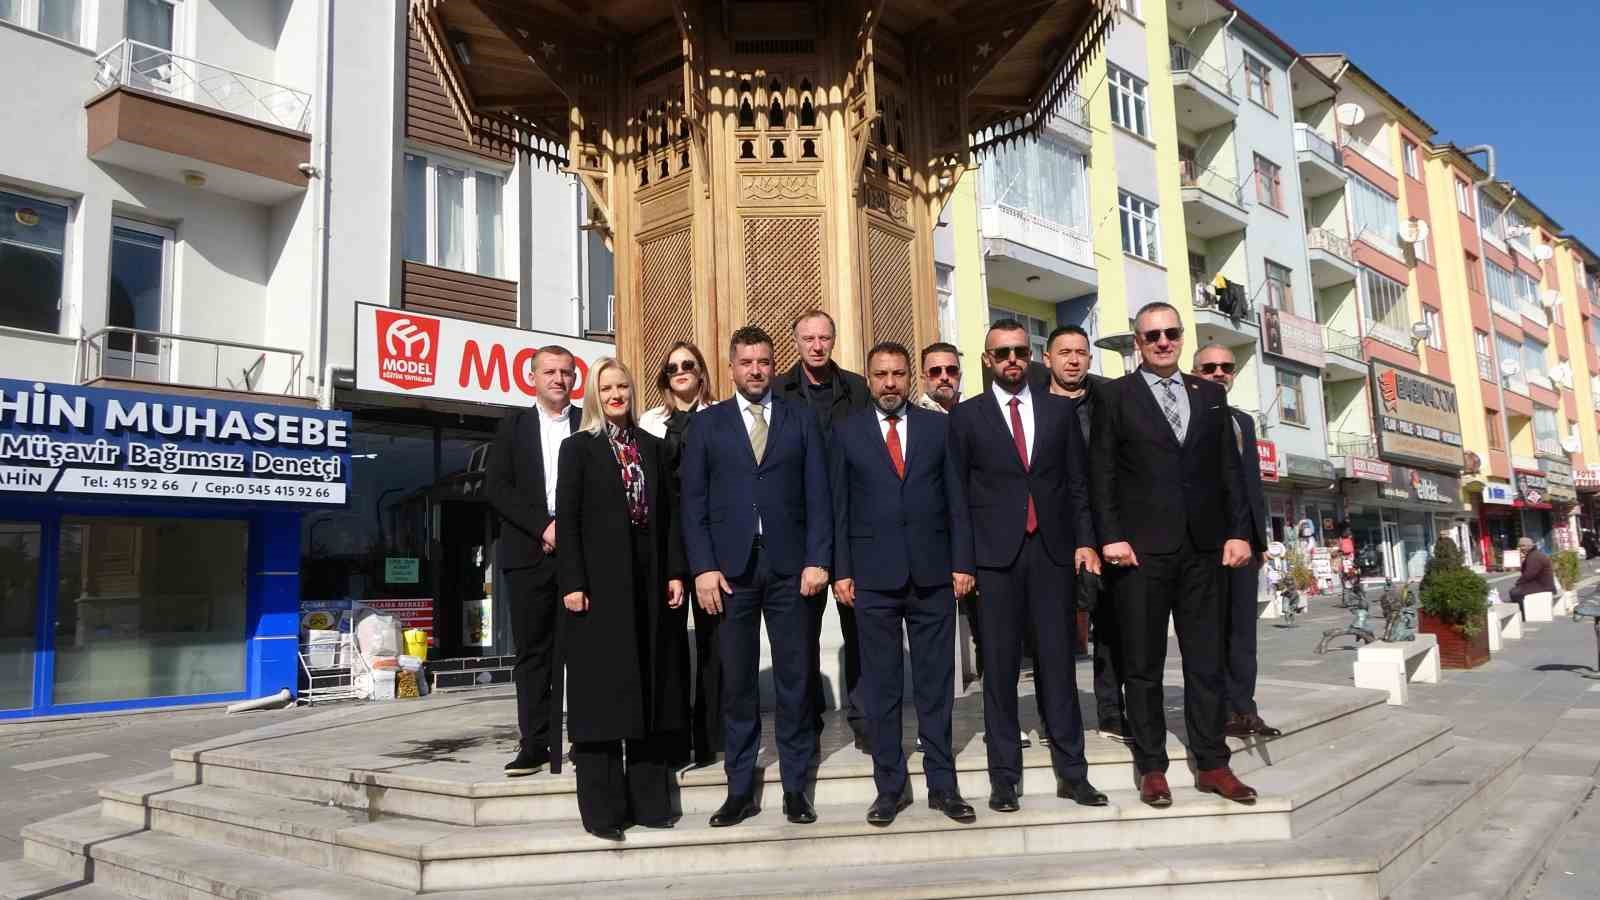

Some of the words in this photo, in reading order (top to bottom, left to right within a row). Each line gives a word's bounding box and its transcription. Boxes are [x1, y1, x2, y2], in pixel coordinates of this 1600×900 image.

[383, 358, 432, 375] MODEL
[105, 399, 348, 448] MUHASEBE
[0, 434, 119, 467] Müşavir
[129, 443, 245, 473] Bağımsız
[253, 451, 341, 481] Denetçi
[81, 475, 109, 488] Tel:
[112, 477, 137, 489] 415
[140, 479, 157, 490] 92
[161, 480, 179, 491] 66
[248, 484, 271, 495] 545
[274, 486, 295, 496] 415
[297, 487, 312, 498] 92
[315, 488, 330, 498] 66
